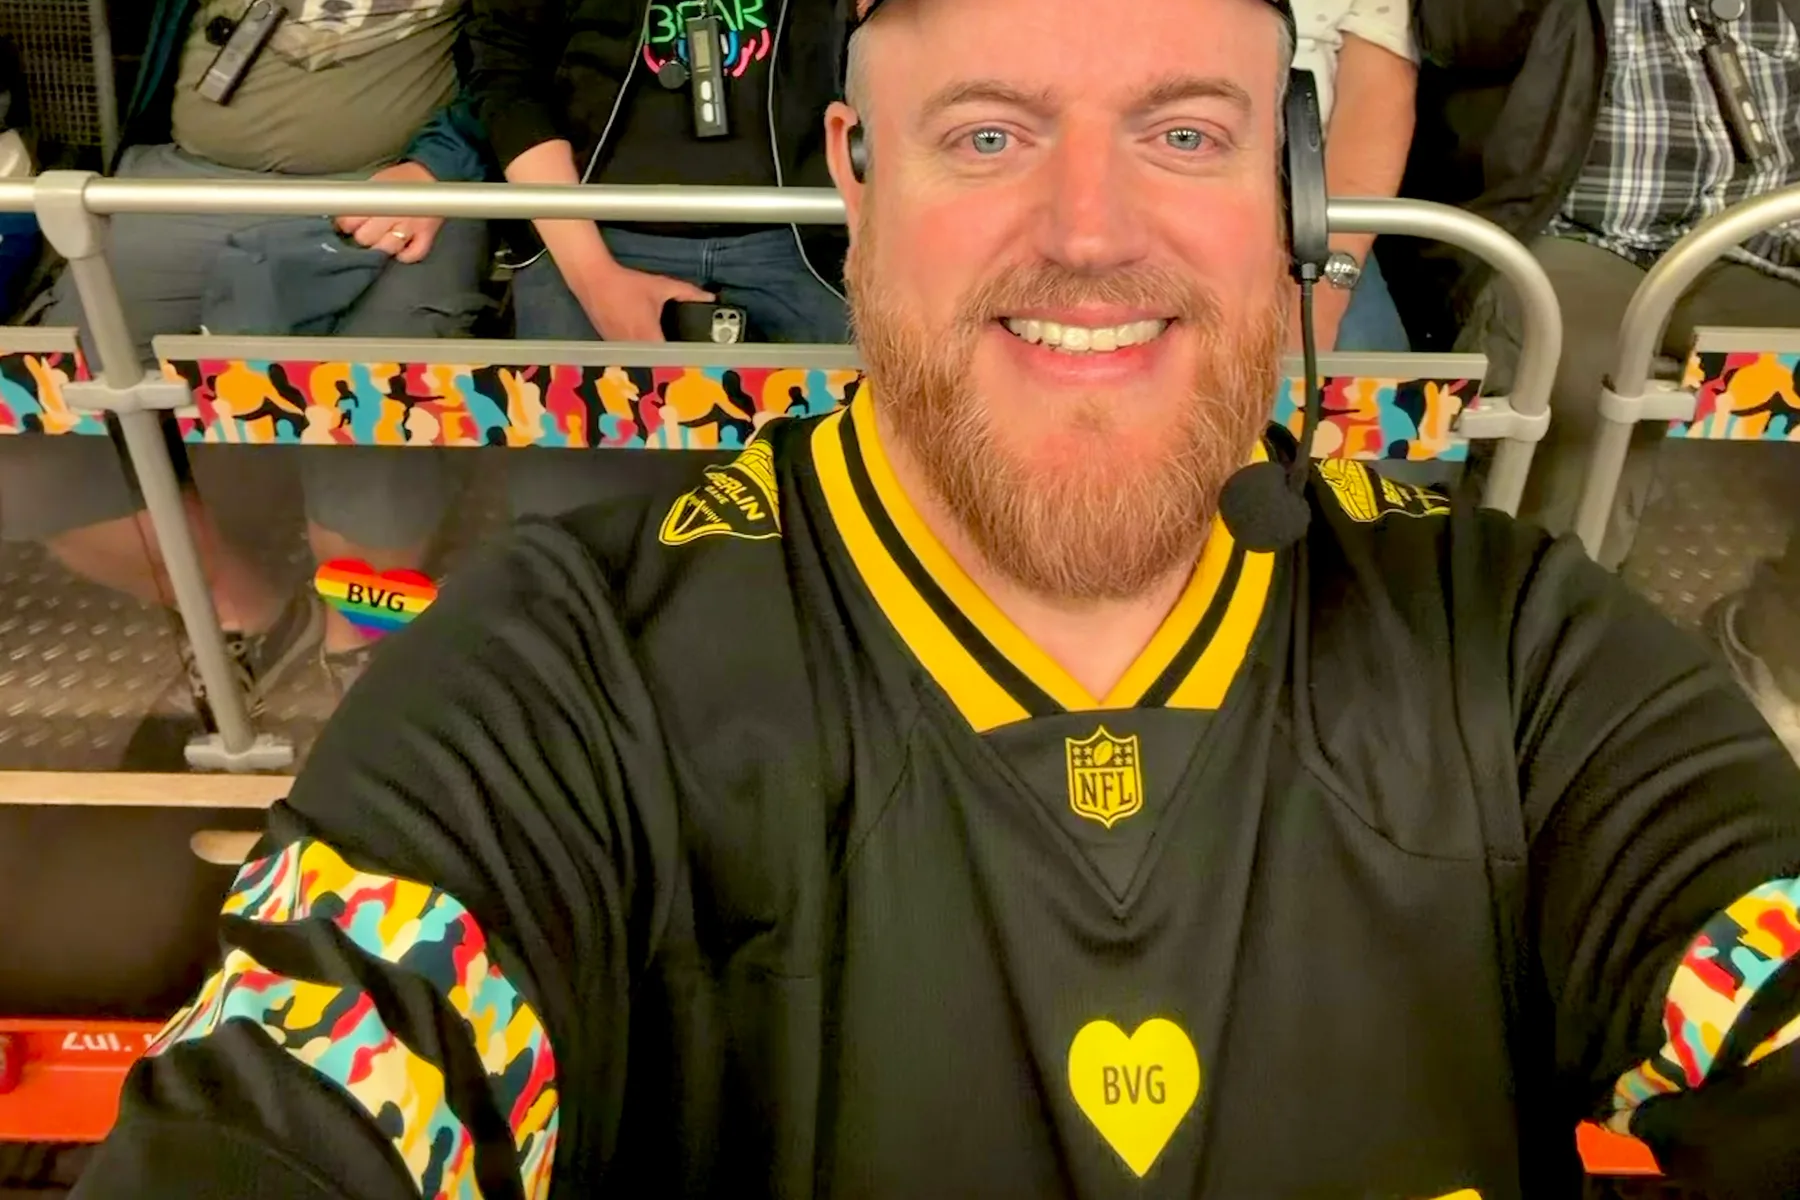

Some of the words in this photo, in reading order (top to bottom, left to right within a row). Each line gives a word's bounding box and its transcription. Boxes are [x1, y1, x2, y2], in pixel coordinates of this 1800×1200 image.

[346, 582, 406, 613] BVG
[1078, 771, 1133, 811] NFL
[1102, 1064, 1167, 1106] BVG
